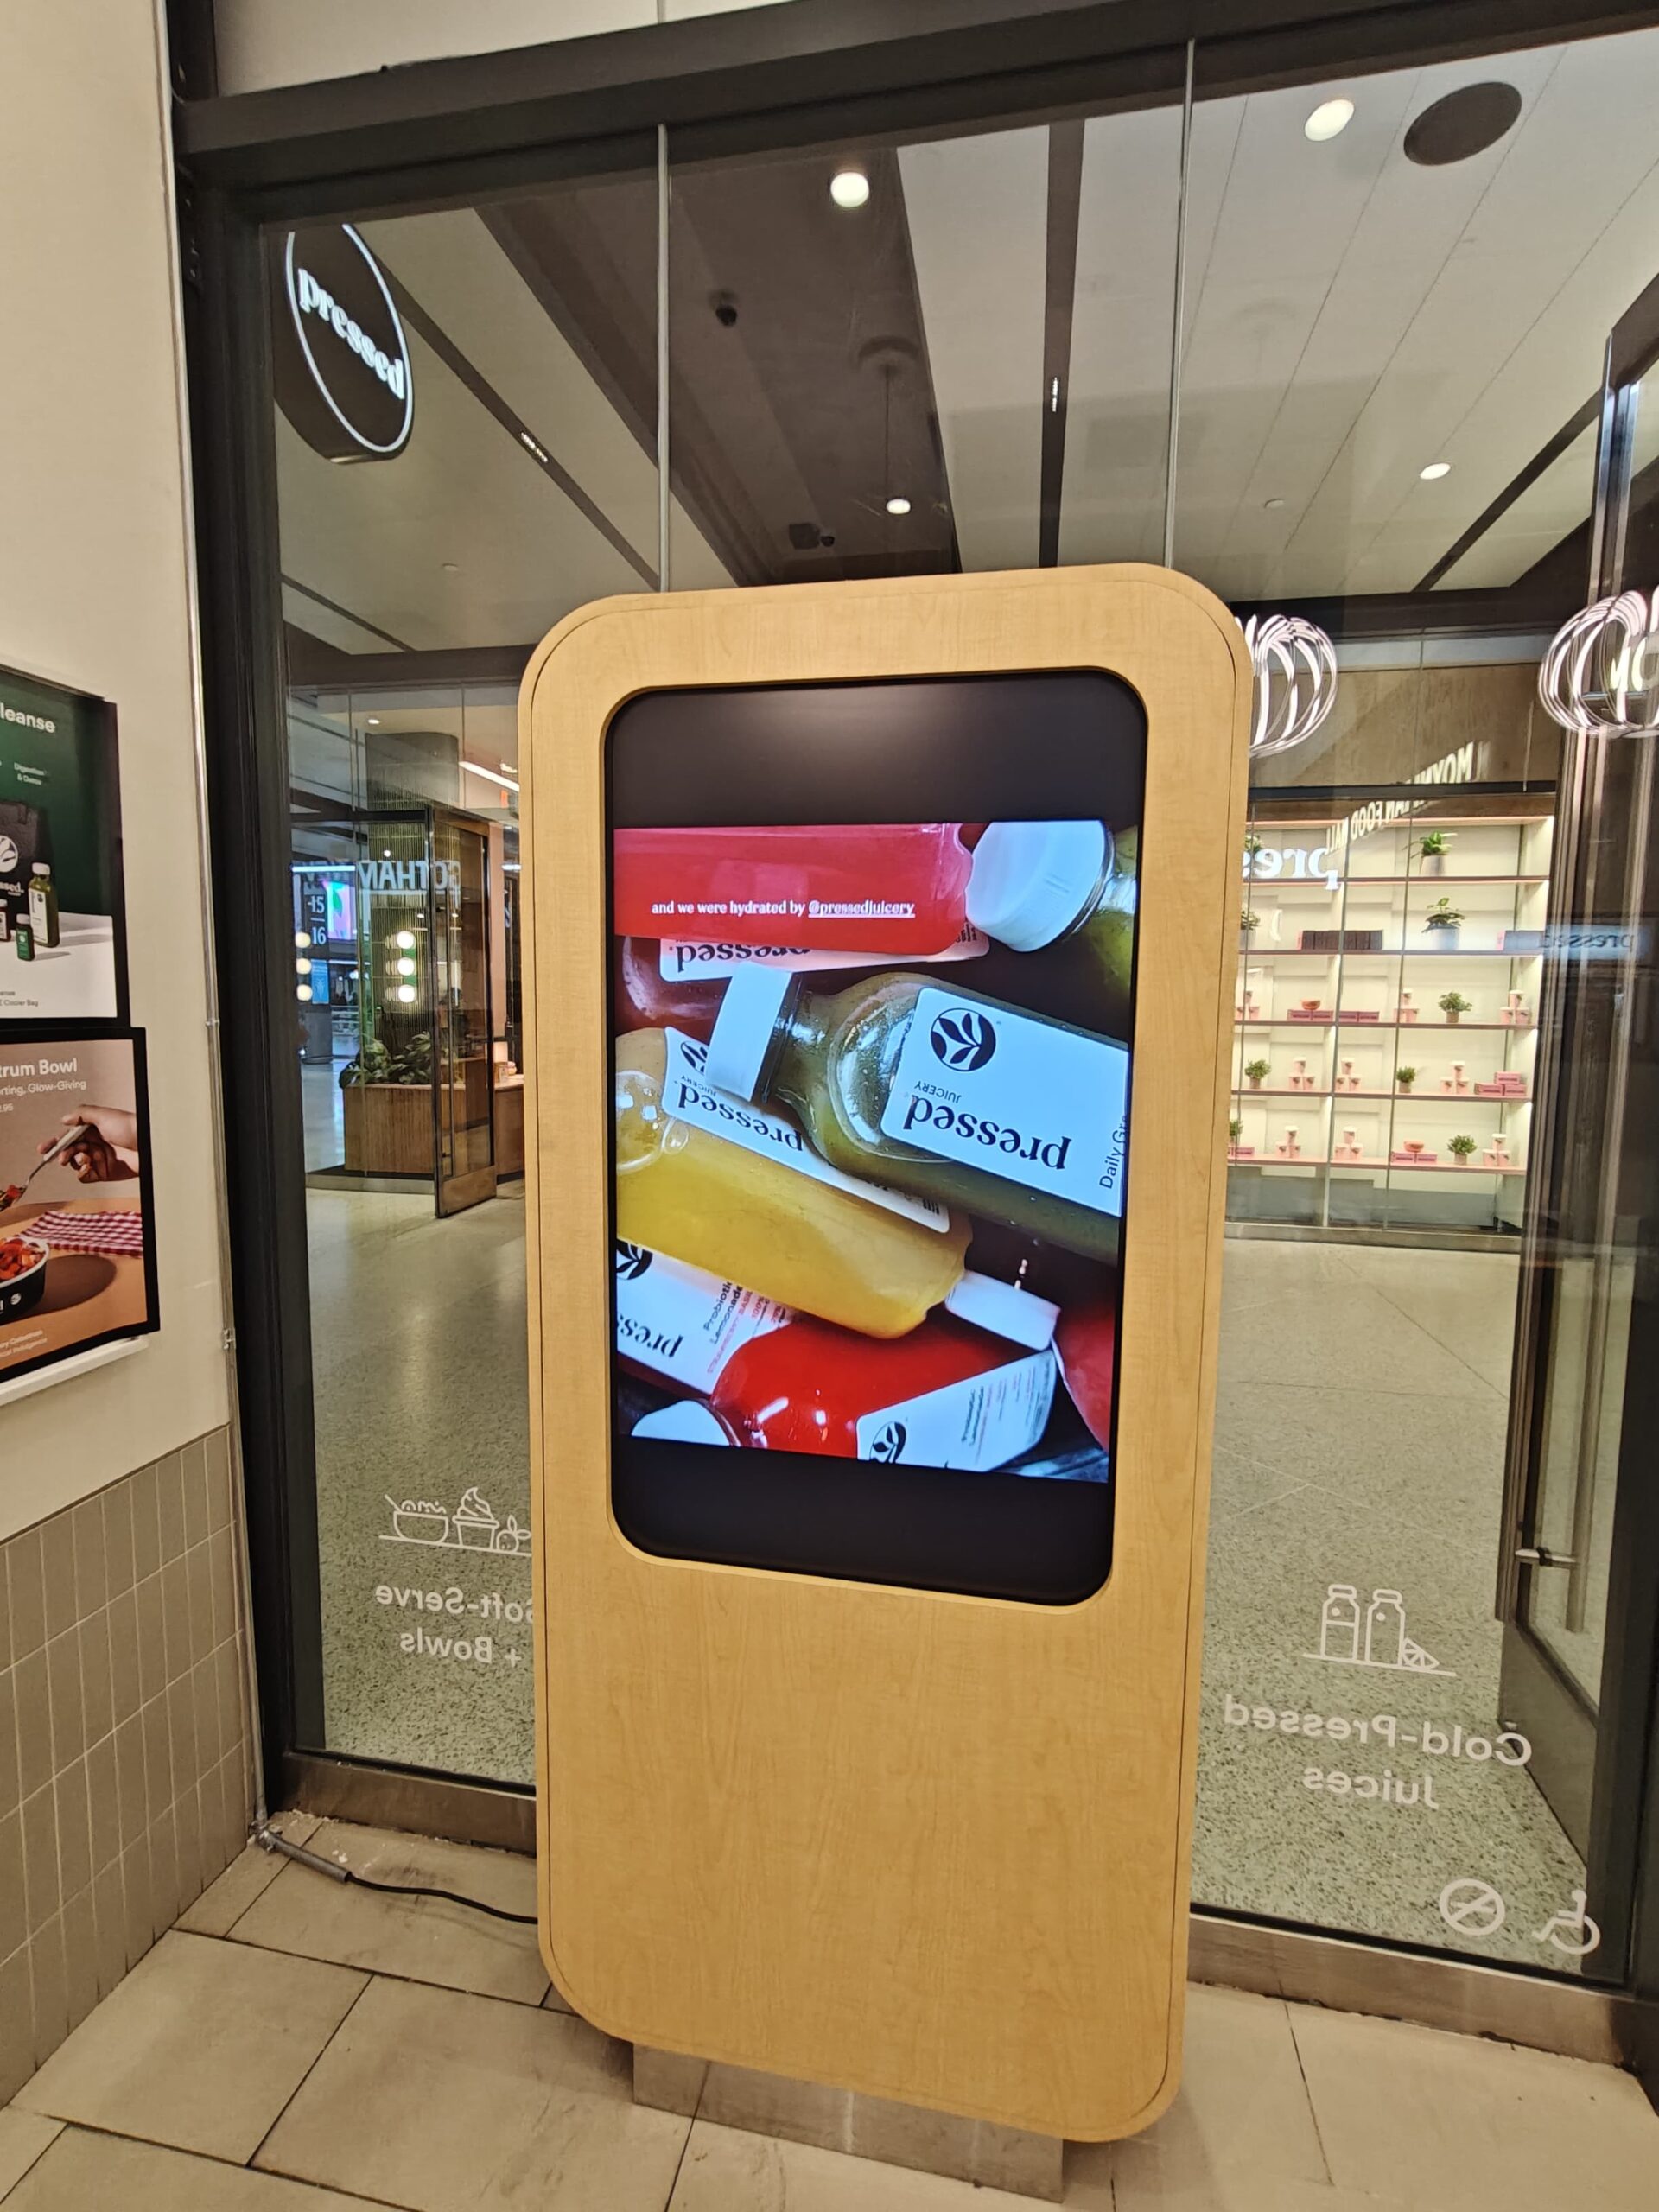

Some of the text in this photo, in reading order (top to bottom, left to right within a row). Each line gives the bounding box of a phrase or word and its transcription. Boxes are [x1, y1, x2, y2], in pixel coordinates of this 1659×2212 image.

[298, 268, 404, 399] pressed
[0, 702, 55, 733] leanse
[652, 899, 914, 917] and we were hydrated by @pressedjuicery
[312, 926, 327, 945] 16
[676, 943, 810, 973] ressed
[39, 1058, 77, 1075] Bowl
[0, 1080, 86, 1096] rting, Glow-Giving
[914, 1080, 962, 1104] JUICERY
[678, 1083, 804, 1151] pressed
[903, 1095, 1073, 1169] pressed
[1099, 1147, 1125, 1189] Daily
[617, 1313, 683, 1358] pres
